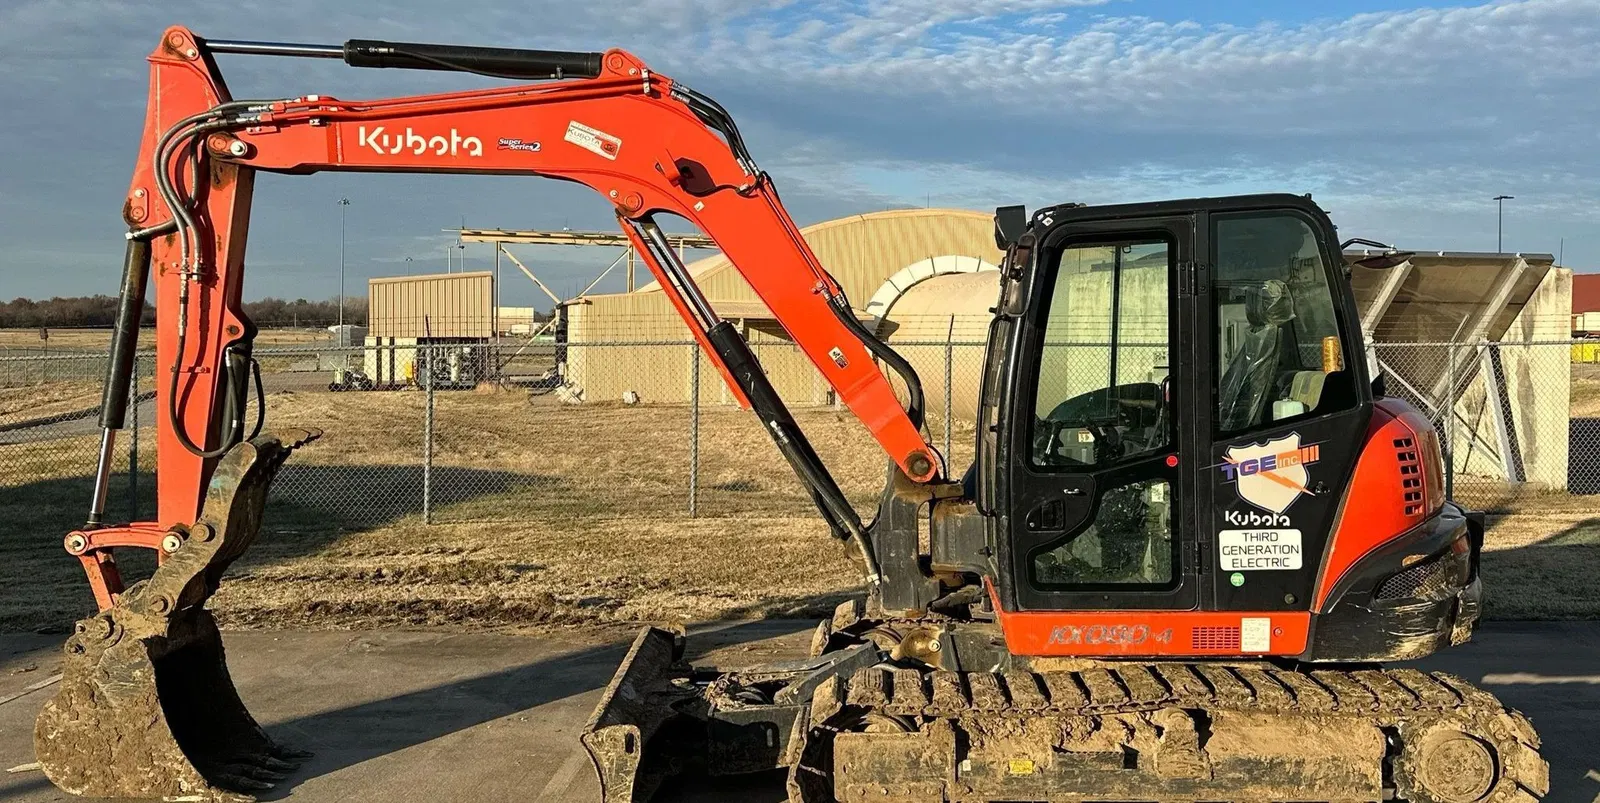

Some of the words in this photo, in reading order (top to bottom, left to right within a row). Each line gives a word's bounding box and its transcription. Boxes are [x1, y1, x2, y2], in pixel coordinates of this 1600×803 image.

[359, 126, 483, 156] Kubota
[1221, 454, 1277, 480] TGE
[1225, 510, 1290, 526] Kubota
[1241, 532, 1279, 542] THIRD
[1222, 544, 1299, 556] GENERATION
[1231, 557, 1290, 569] ELECTRIC
